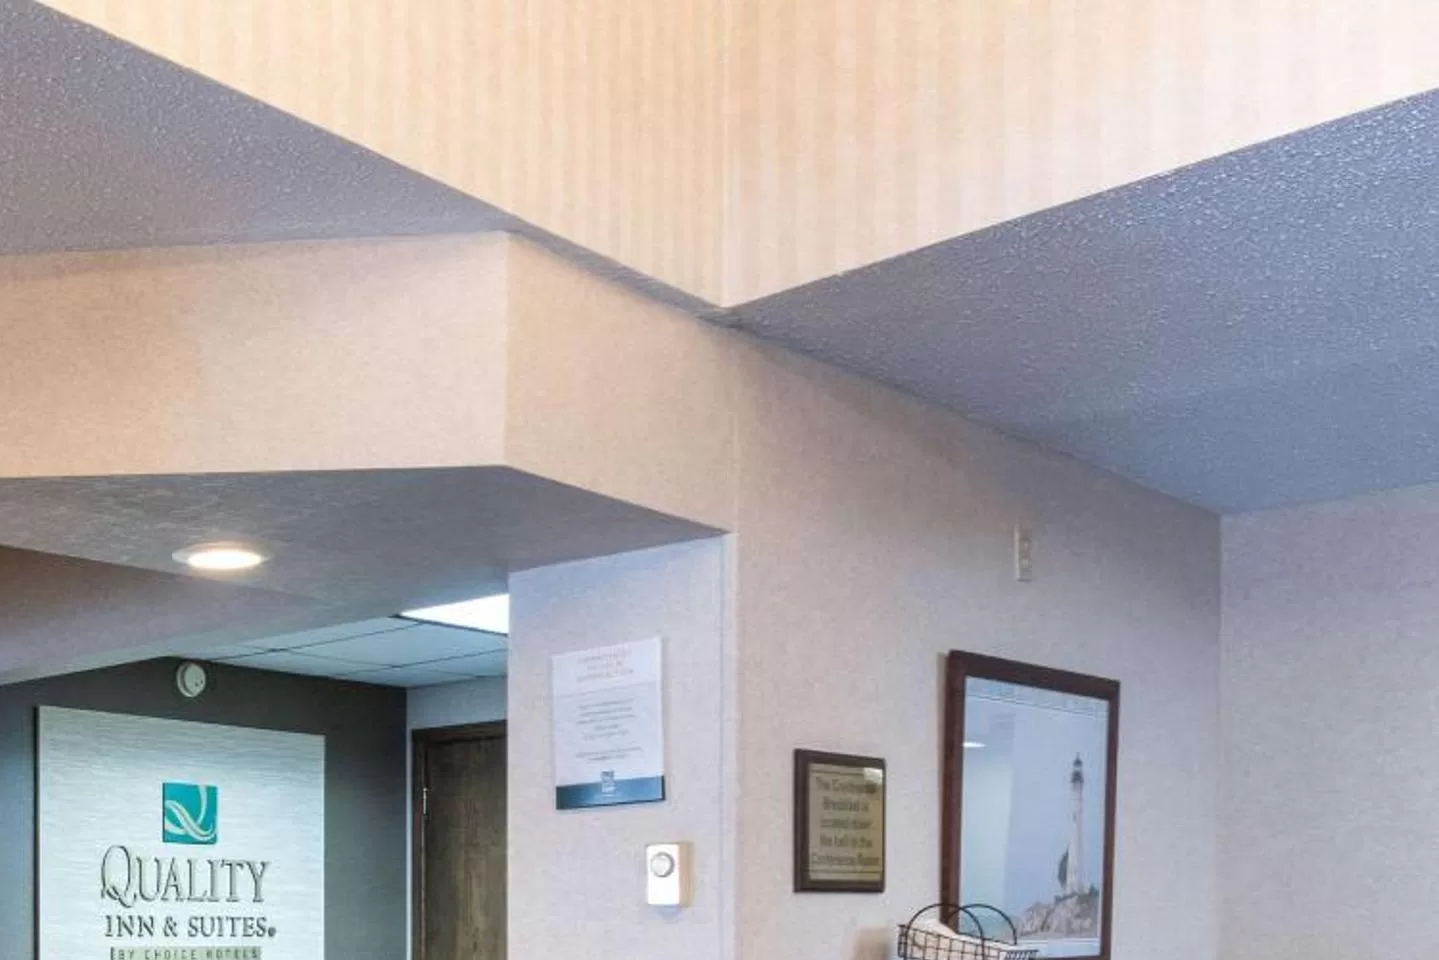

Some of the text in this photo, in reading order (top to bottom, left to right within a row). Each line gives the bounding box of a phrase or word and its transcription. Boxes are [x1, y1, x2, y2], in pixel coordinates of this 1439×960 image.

[100, 844, 271, 908] QUALITY
[104, 914, 155, 938] INN
[162, 915, 179, 938] &
[117, 948, 135, 960] BY
[144, 948, 197, 960] CHOICE
